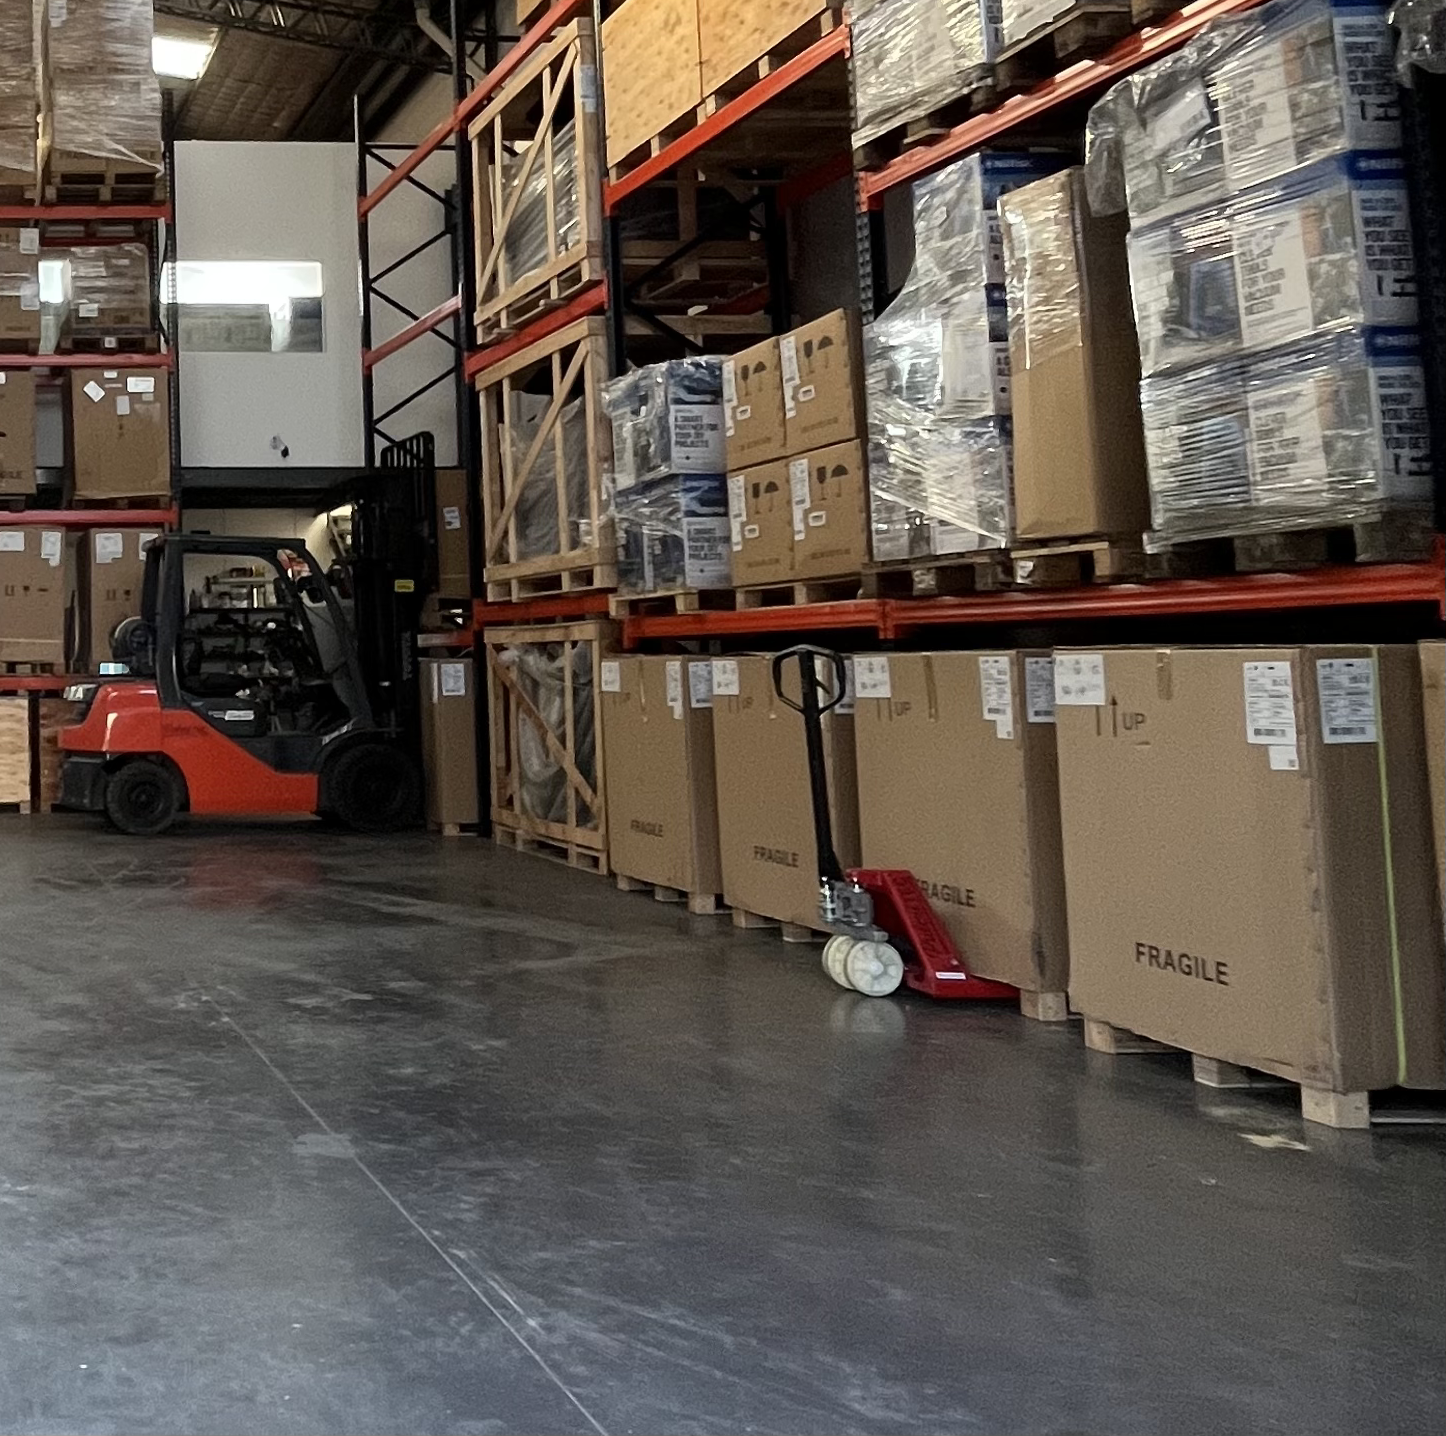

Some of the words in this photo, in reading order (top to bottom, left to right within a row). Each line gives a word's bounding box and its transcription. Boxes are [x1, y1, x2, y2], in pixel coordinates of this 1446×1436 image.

[1123, 713, 1146, 730] UP
[754, 845, 800, 868] FRAGILE
[1135, 942, 1229, 986] FRAGILE
